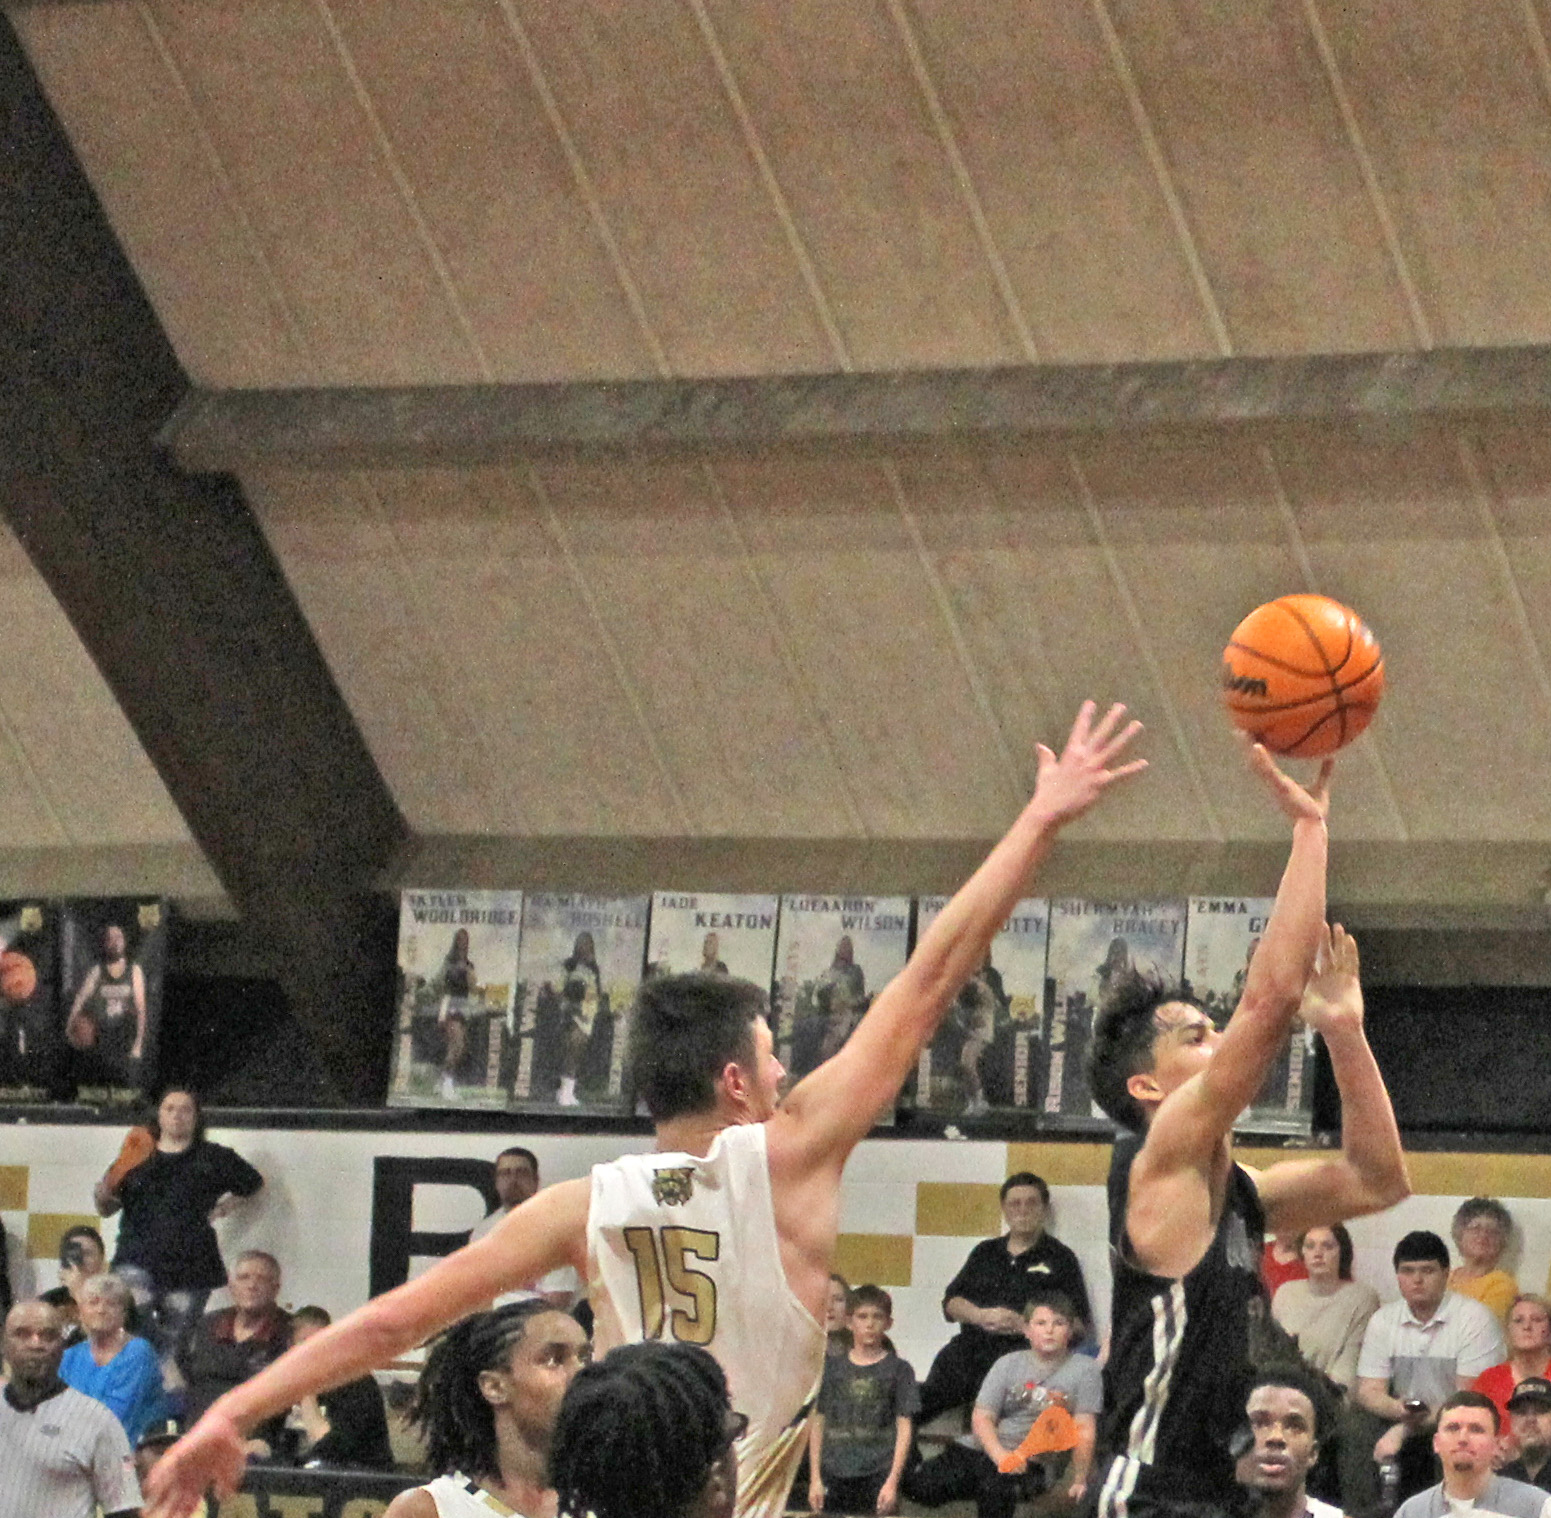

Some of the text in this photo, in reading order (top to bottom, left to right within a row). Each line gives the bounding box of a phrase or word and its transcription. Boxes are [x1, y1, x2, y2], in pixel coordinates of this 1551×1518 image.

[1197, 902, 1247, 914] EMMA
[694, 911, 772, 930] KEATON
[842, 914, 906, 930] WILSON
[622, 1226, 720, 1346] 15
